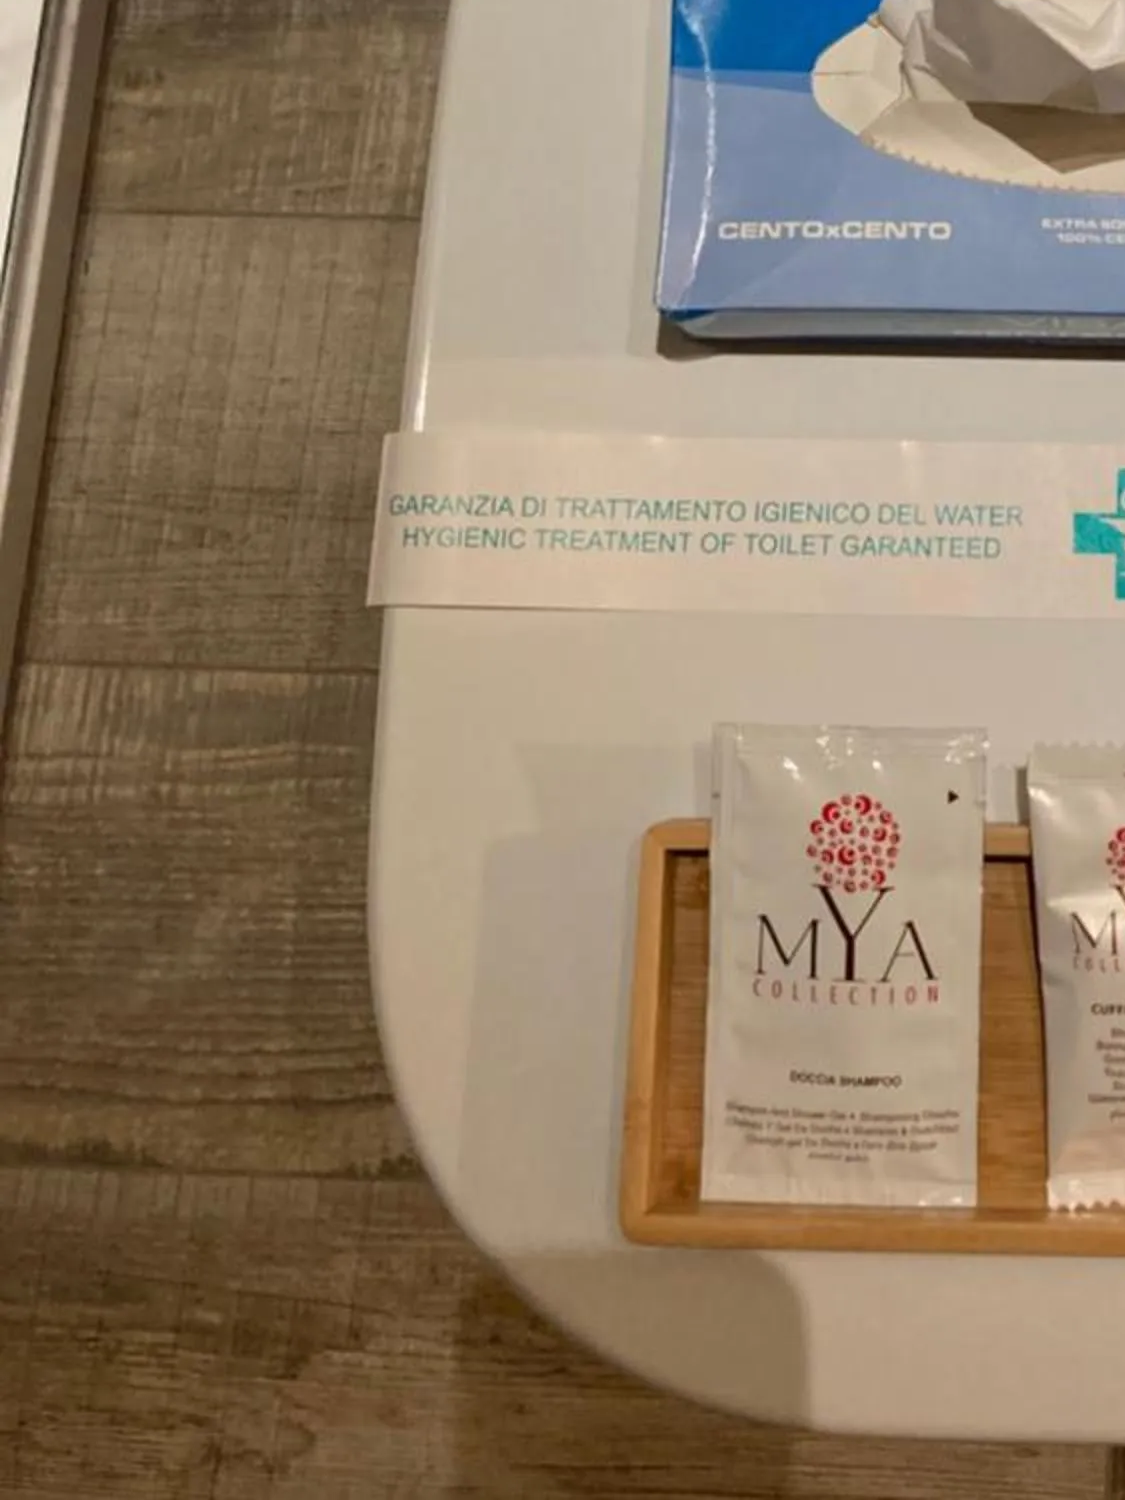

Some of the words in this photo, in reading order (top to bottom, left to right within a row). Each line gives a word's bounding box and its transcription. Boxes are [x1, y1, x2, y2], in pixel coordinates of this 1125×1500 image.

[718, 221, 952, 240] CENTOxCENTO
[1041, 218, 1098, 230] EXTRA
[389, 494, 515, 517] GARANZIA
[521, 496, 547, 518] DI
[557, 497, 747, 523] TRATTAMENTO
[754, 501, 871, 525] IGIENICO
[877, 503, 927, 527] DEL
[933, 503, 1023, 528] WATER
[402, 526, 527, 550] HYGIENIC
[535, 528, 693, 554] TREATMENT
[701, 531, 737, 555] OF
[743, 533, 834, 557] TOILET
[840, 534, 1002, 560] GARANTEED
[753, 884, 939, 983] MYA
[753, 978, 939, 1005] COLLECTION
